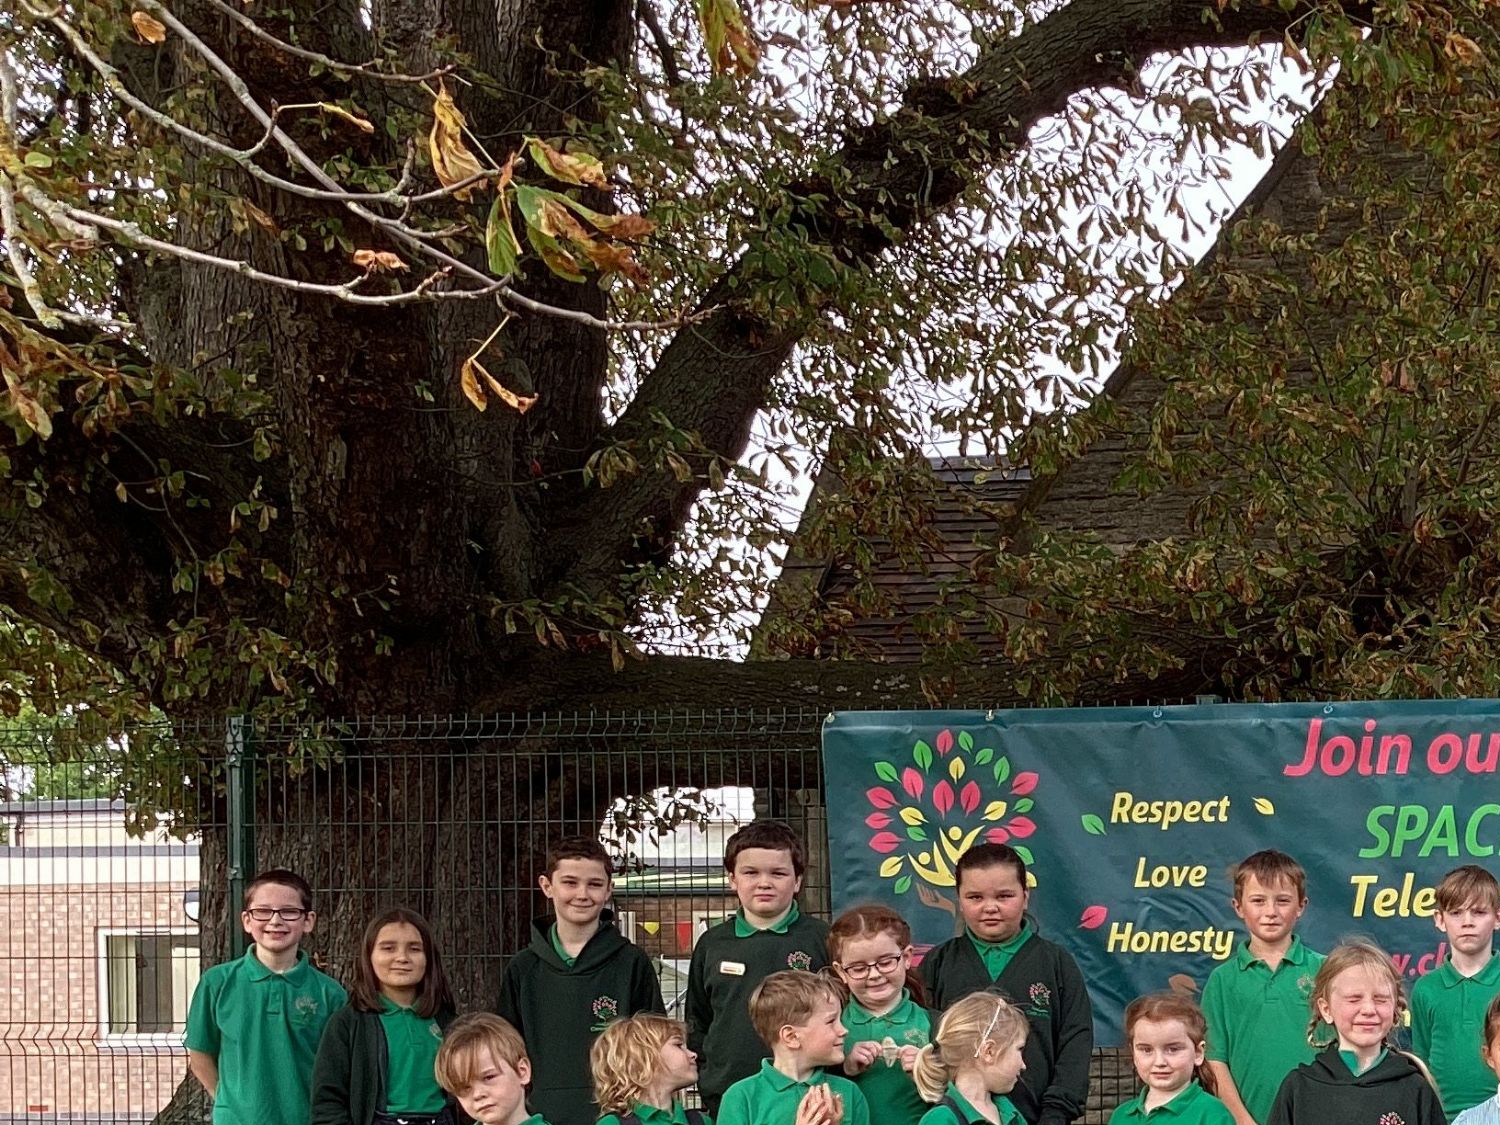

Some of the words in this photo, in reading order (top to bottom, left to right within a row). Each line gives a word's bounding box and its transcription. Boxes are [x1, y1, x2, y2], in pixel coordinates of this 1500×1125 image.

[1282, 717, 1413, 777] Join
[1110, 791, 1231, 830] Respect
[1133, 857, 1208, 888] Love
[1107, 922, 1235, 960] Honesty
